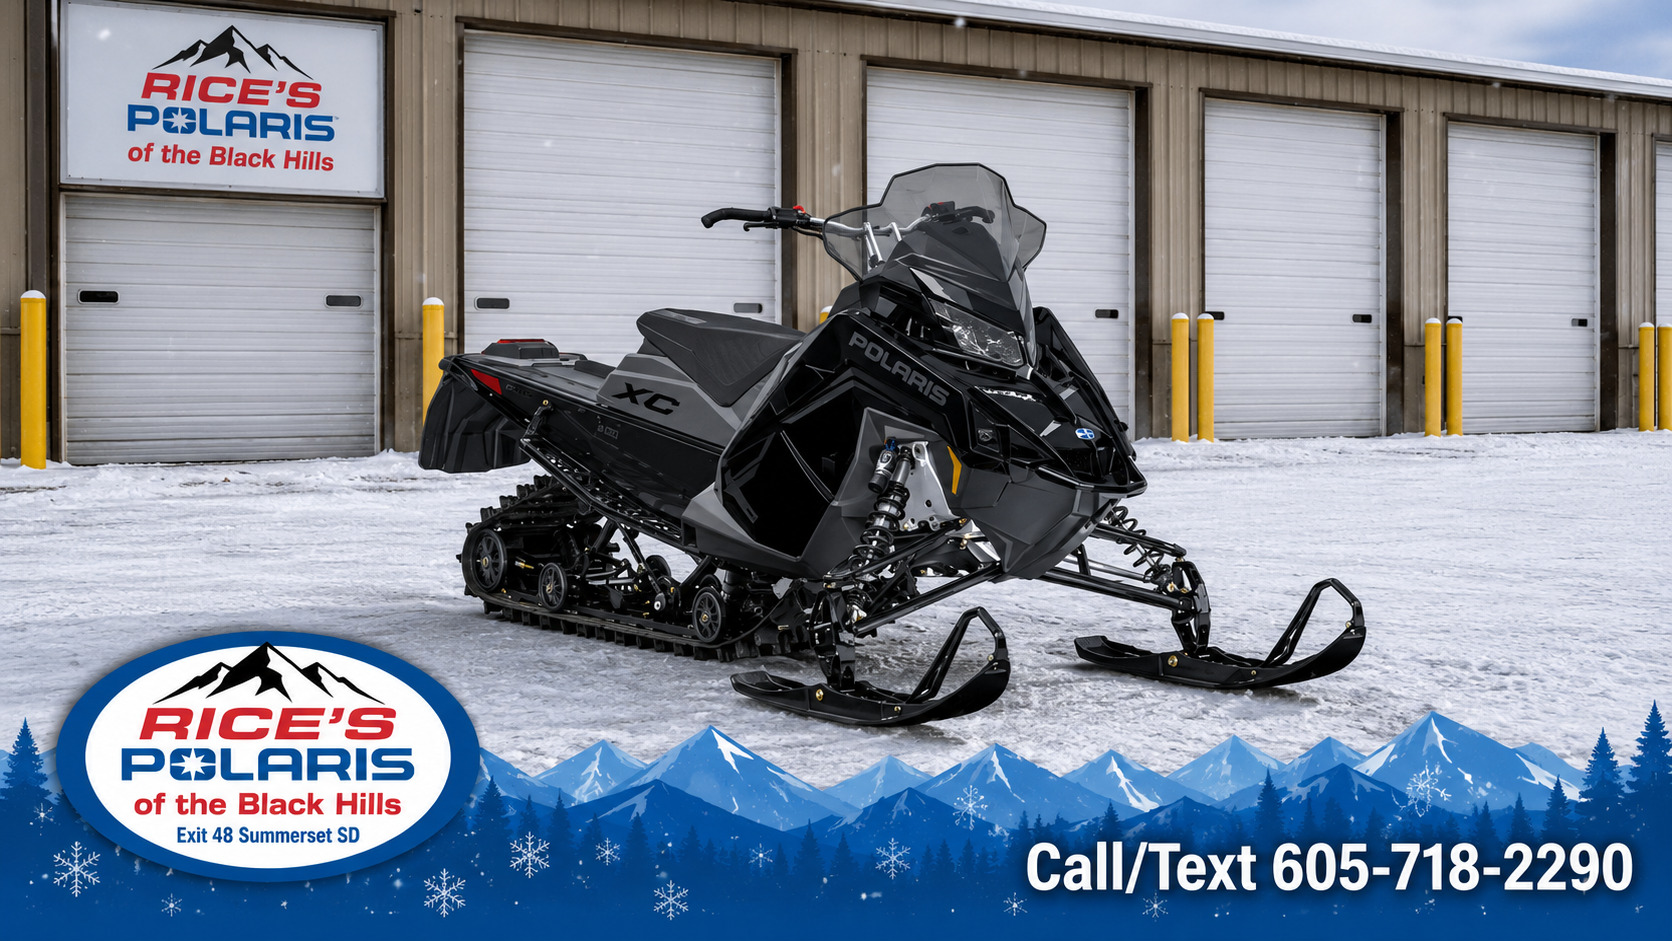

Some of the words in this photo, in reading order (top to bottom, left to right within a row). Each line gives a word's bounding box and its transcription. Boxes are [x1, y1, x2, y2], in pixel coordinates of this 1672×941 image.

[141, 72, 322, 108] RICE'S
[127, 104, 335, 142] POLARIS
[128, 142, 155, 163] of
[161, 144, 201, 165] the
[209, 146, 276, 169] Black
[283, 150, 334, 171] Hills
[848, 331, 950, 407] POLARIS
[611, 382, 680, 415] XC
